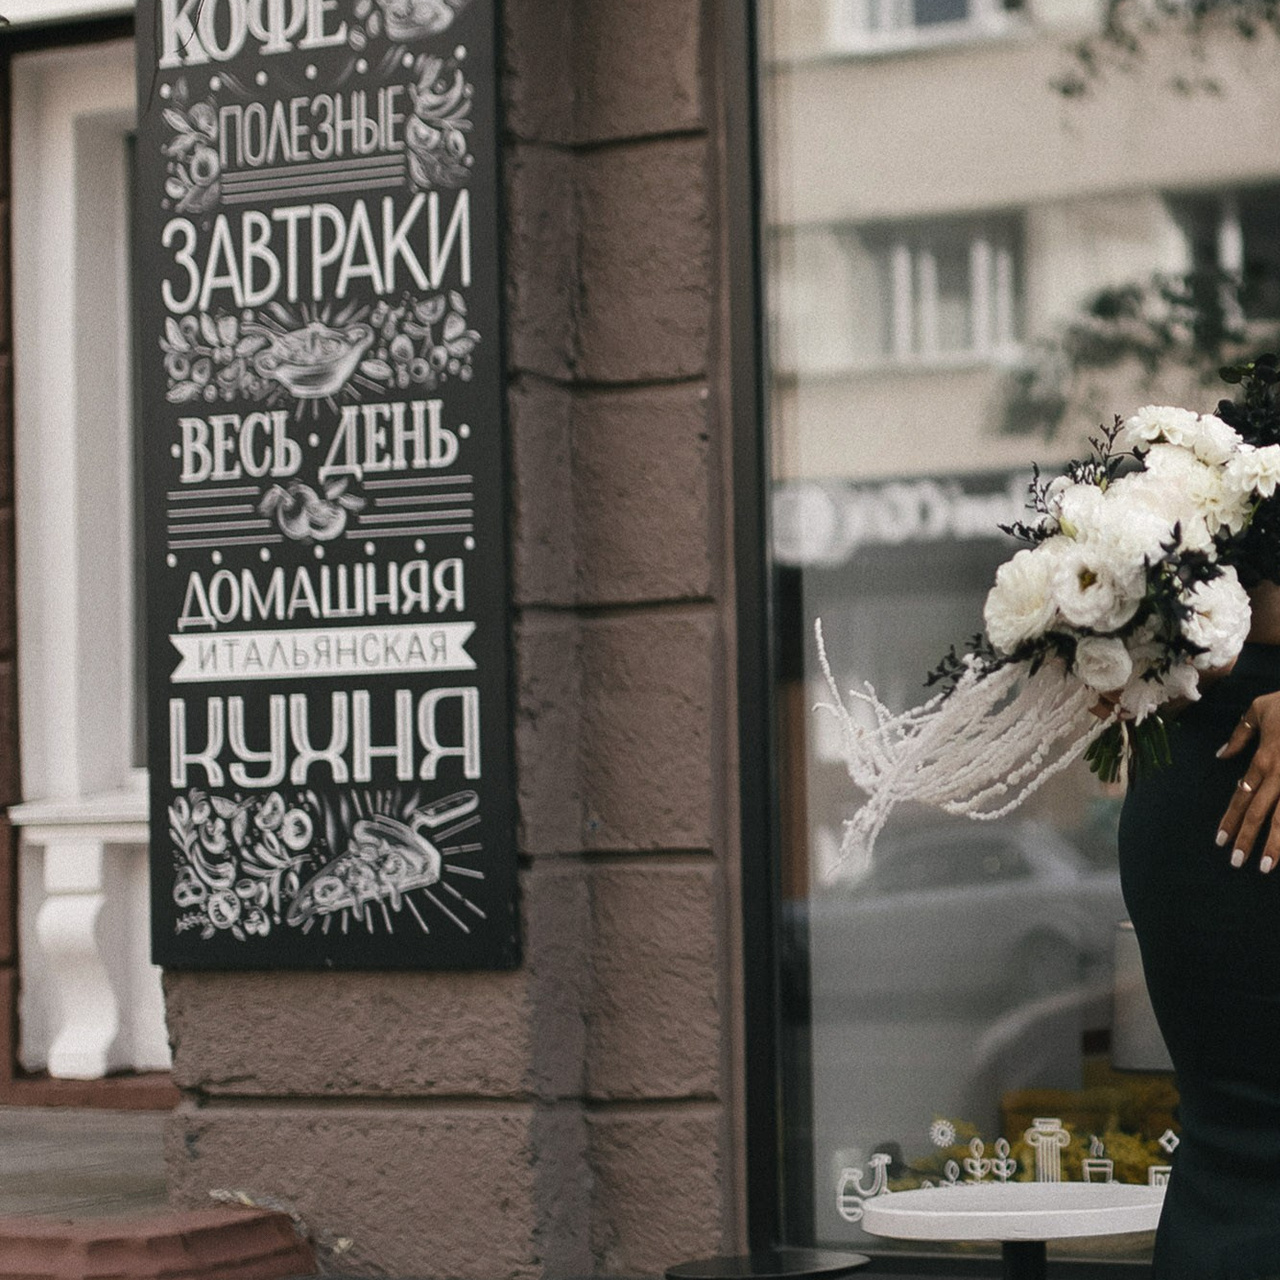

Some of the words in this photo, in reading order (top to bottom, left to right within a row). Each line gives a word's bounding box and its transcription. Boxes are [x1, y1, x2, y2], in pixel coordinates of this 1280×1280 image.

[219, 84, 405, 168] ПОЛЕЗНЫЕ
[161, 188, 472, 314] ЗАВТРАКИ
[180, 410, 302, 484] ВЕСЬ
[318, 399, 459, 483] ДЕНЬ
[177, 558, 466, 631] ДОМАШНЯЯ
[198, 629, 449, 672] ИТАЛЬЯНСКАЯ
[169, 686, 482, 789] КУХНЯ
